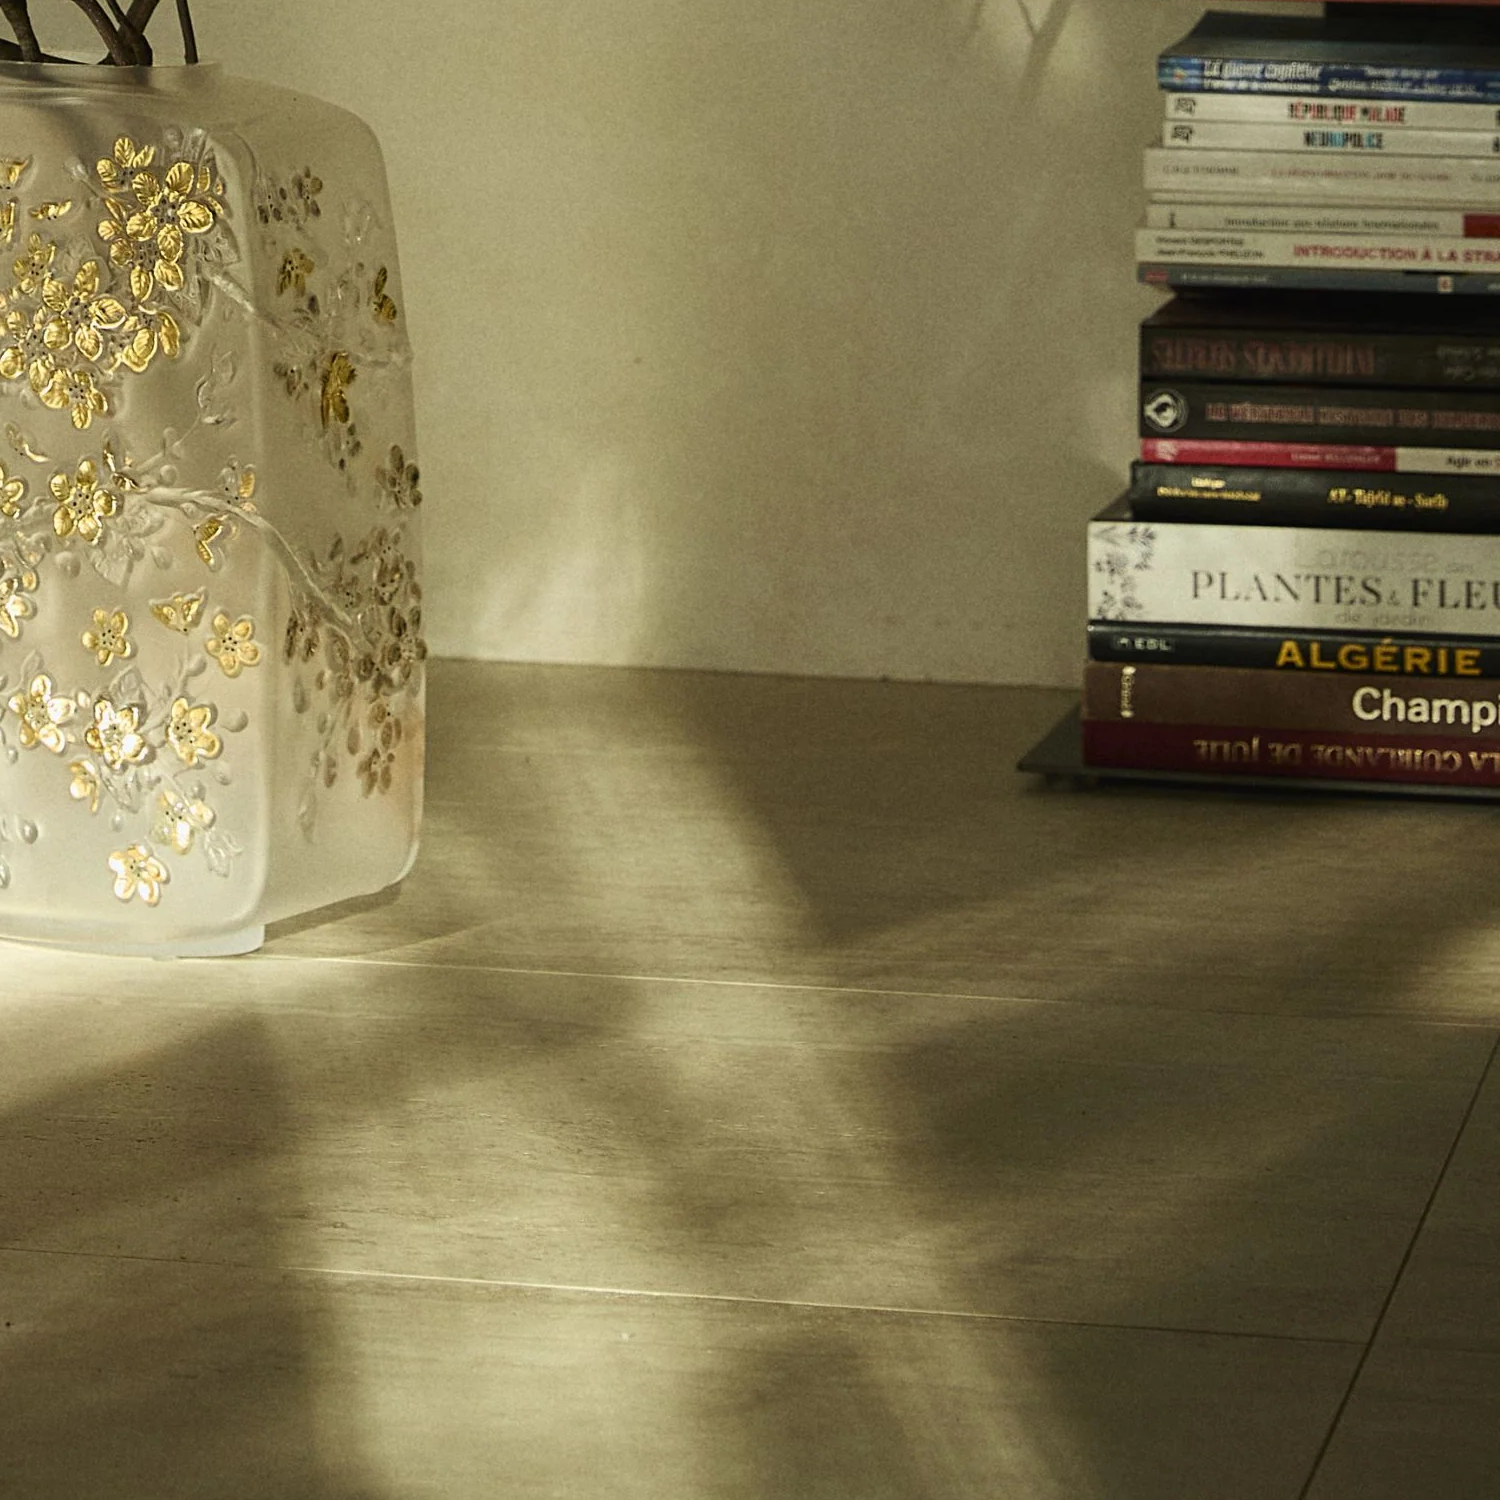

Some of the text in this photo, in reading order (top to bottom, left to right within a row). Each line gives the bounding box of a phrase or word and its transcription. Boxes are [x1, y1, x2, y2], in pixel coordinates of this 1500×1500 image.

[1293, 244, 1418, 262] INTRODUCTION
[1437, 250, 1458, 262] LA
[1191, 569, 1383, 607] PLANTES
[1276, 637, 1482, 676] ALGÉRIE
[1352, 686, 1500, 733] Champ
[1193, 734, 1260, 763] JULIE
[1267, 741, 1302, 765] DE
[1309, 744, 1463, 773] GUIRLANDE
